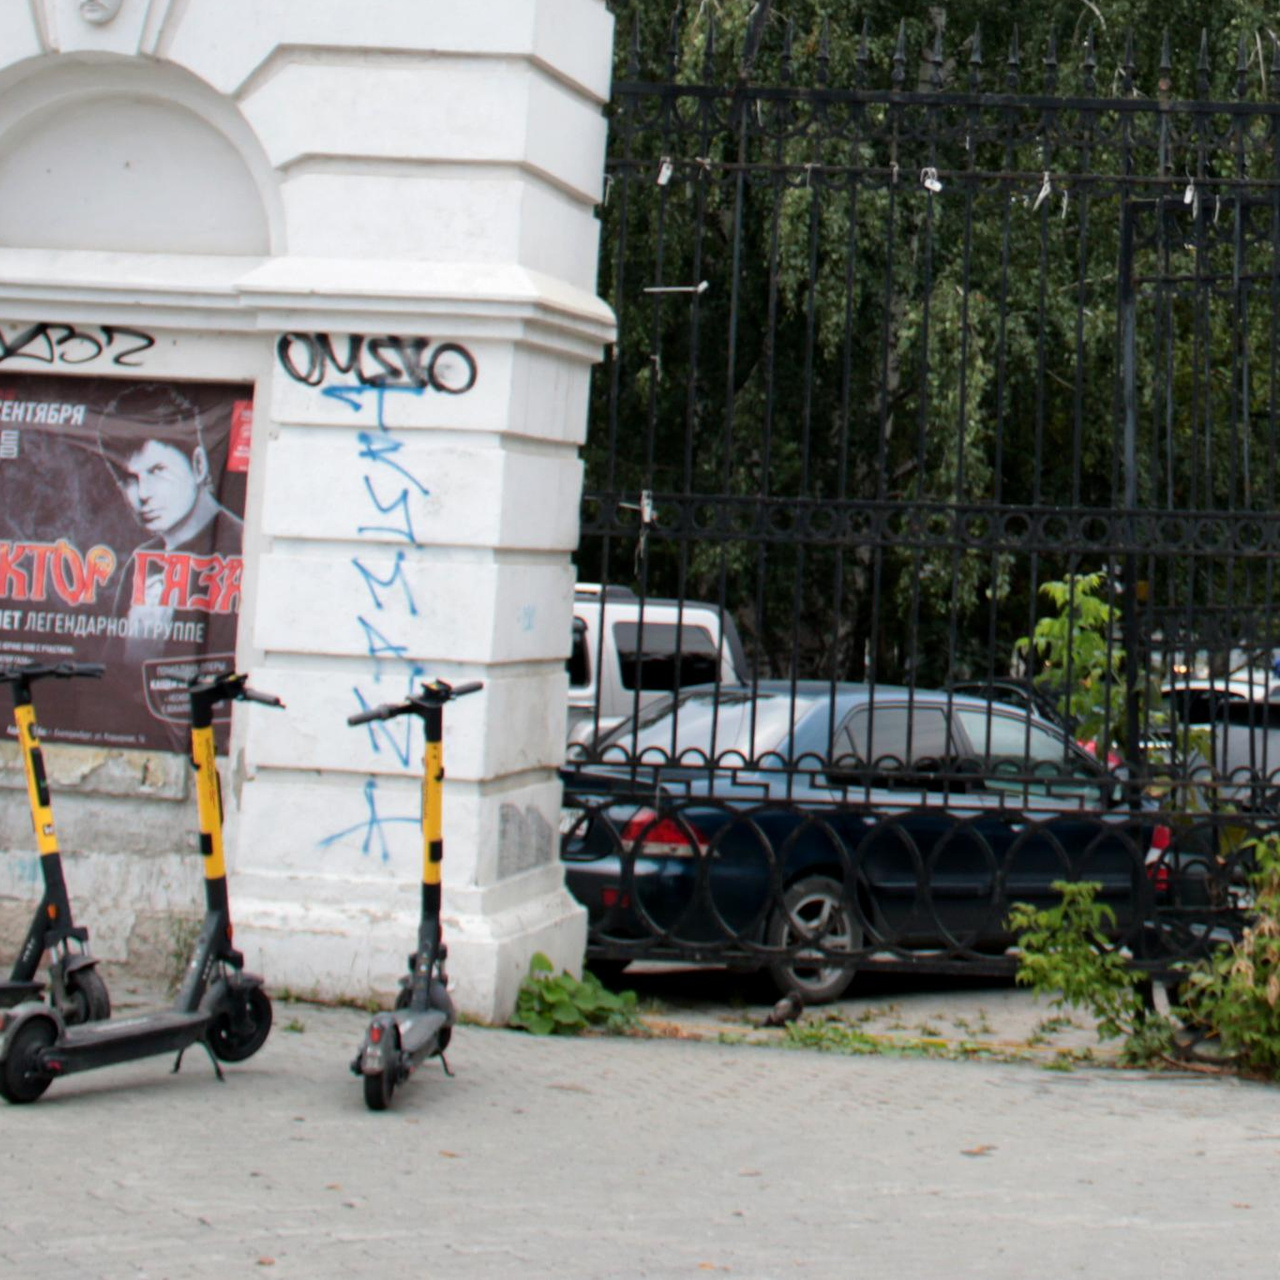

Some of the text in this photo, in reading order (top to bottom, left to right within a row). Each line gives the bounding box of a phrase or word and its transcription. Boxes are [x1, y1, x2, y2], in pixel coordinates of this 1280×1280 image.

[0, 401, 87, 426] ЕНТЯБРЯ
[0, 609, 205, 643] ЕТ ЛЕГЕНДАРНОЙ ГРУППЕ
